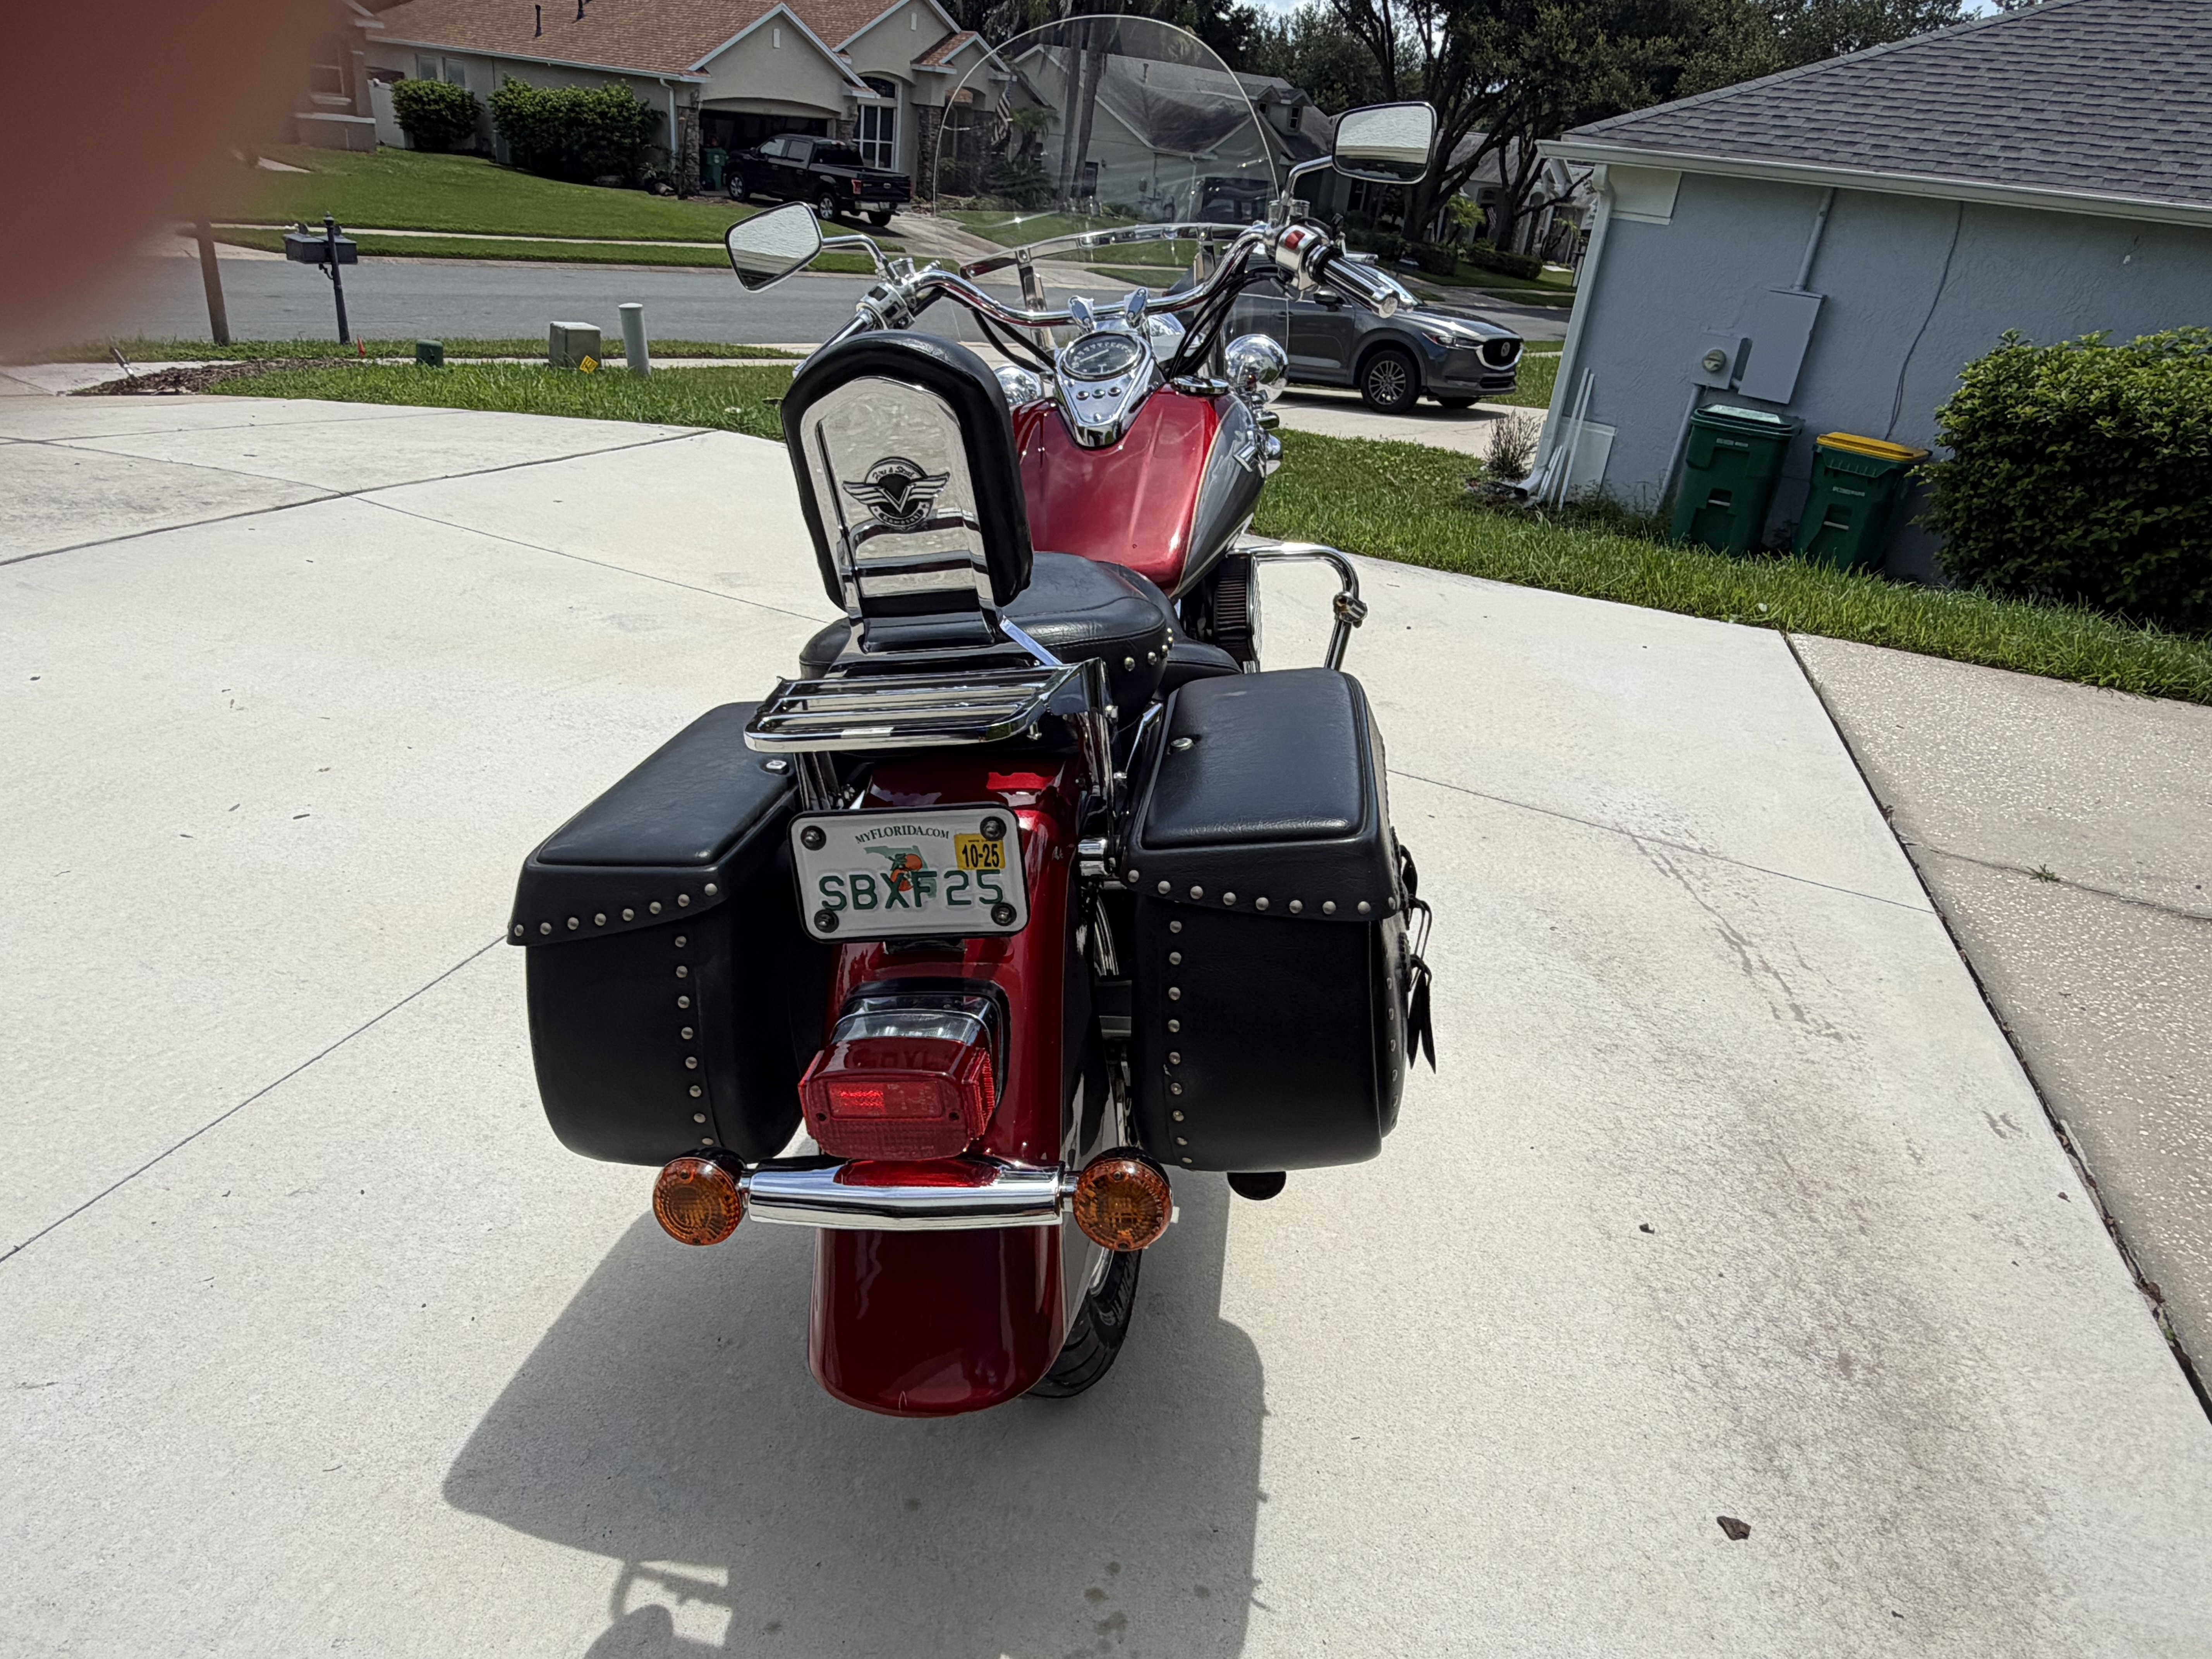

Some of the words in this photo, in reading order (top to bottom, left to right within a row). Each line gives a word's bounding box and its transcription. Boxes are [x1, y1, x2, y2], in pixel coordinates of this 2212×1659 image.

[855, 825, 949, 844] MYFLORIDA.COM
[962, 843, 1000, 867] 10-25
[819, 869, 1003, 911] SBXF25
